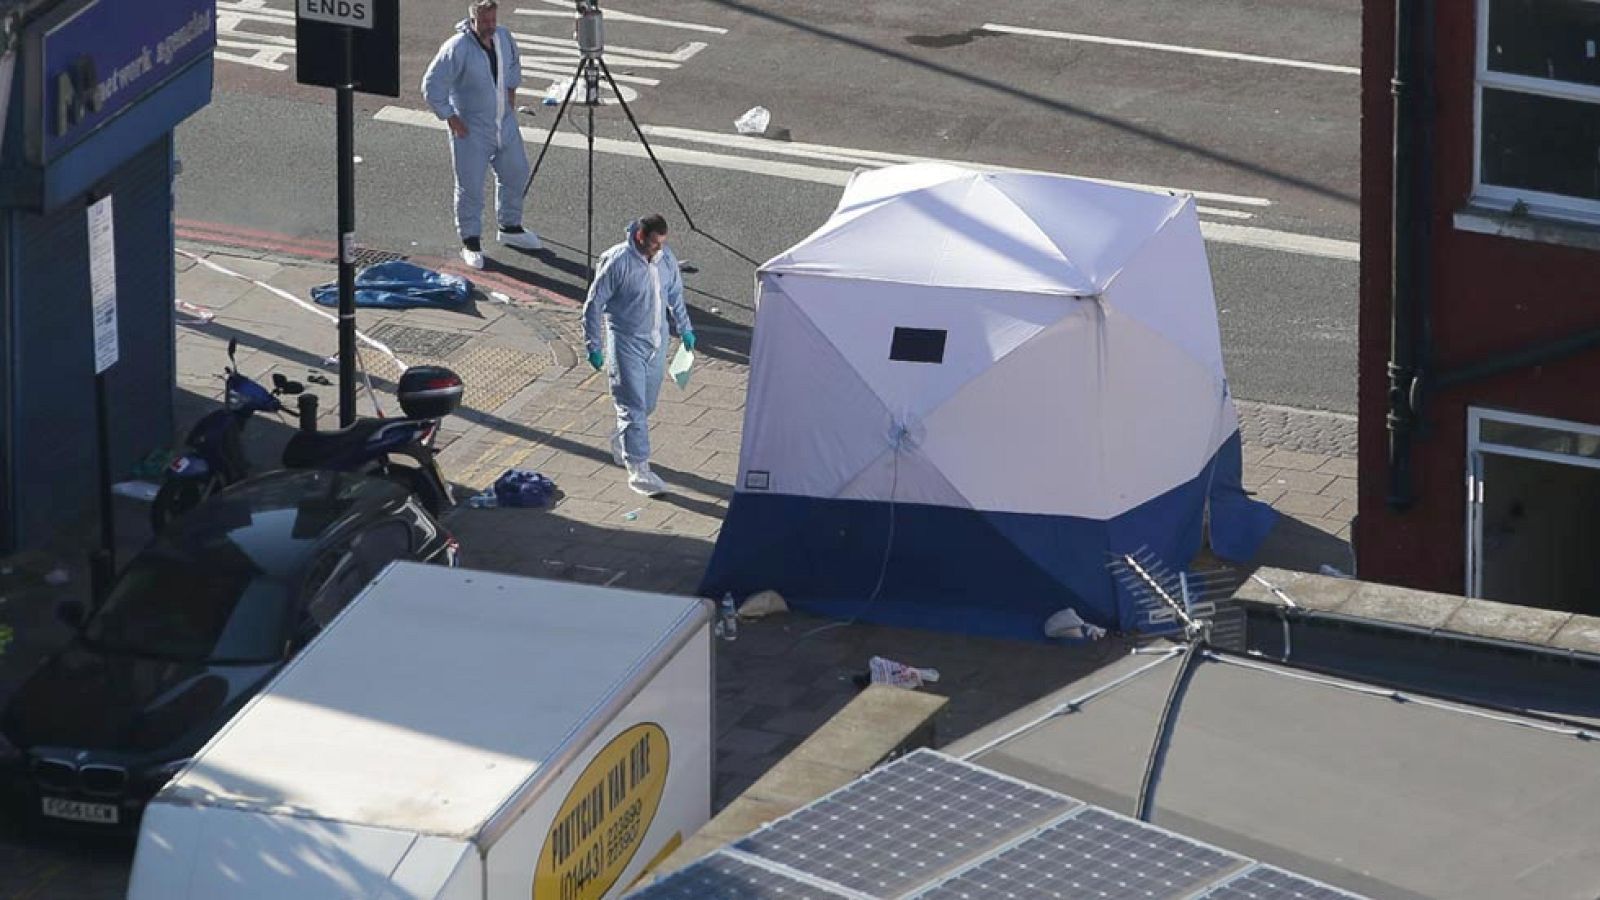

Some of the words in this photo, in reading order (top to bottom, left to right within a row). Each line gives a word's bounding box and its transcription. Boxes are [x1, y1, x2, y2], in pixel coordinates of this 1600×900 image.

[307, 0, 365, 19] ENDS
[608, 757, 626, 812] VAN
[630, 732, 650, 789] HIRE
